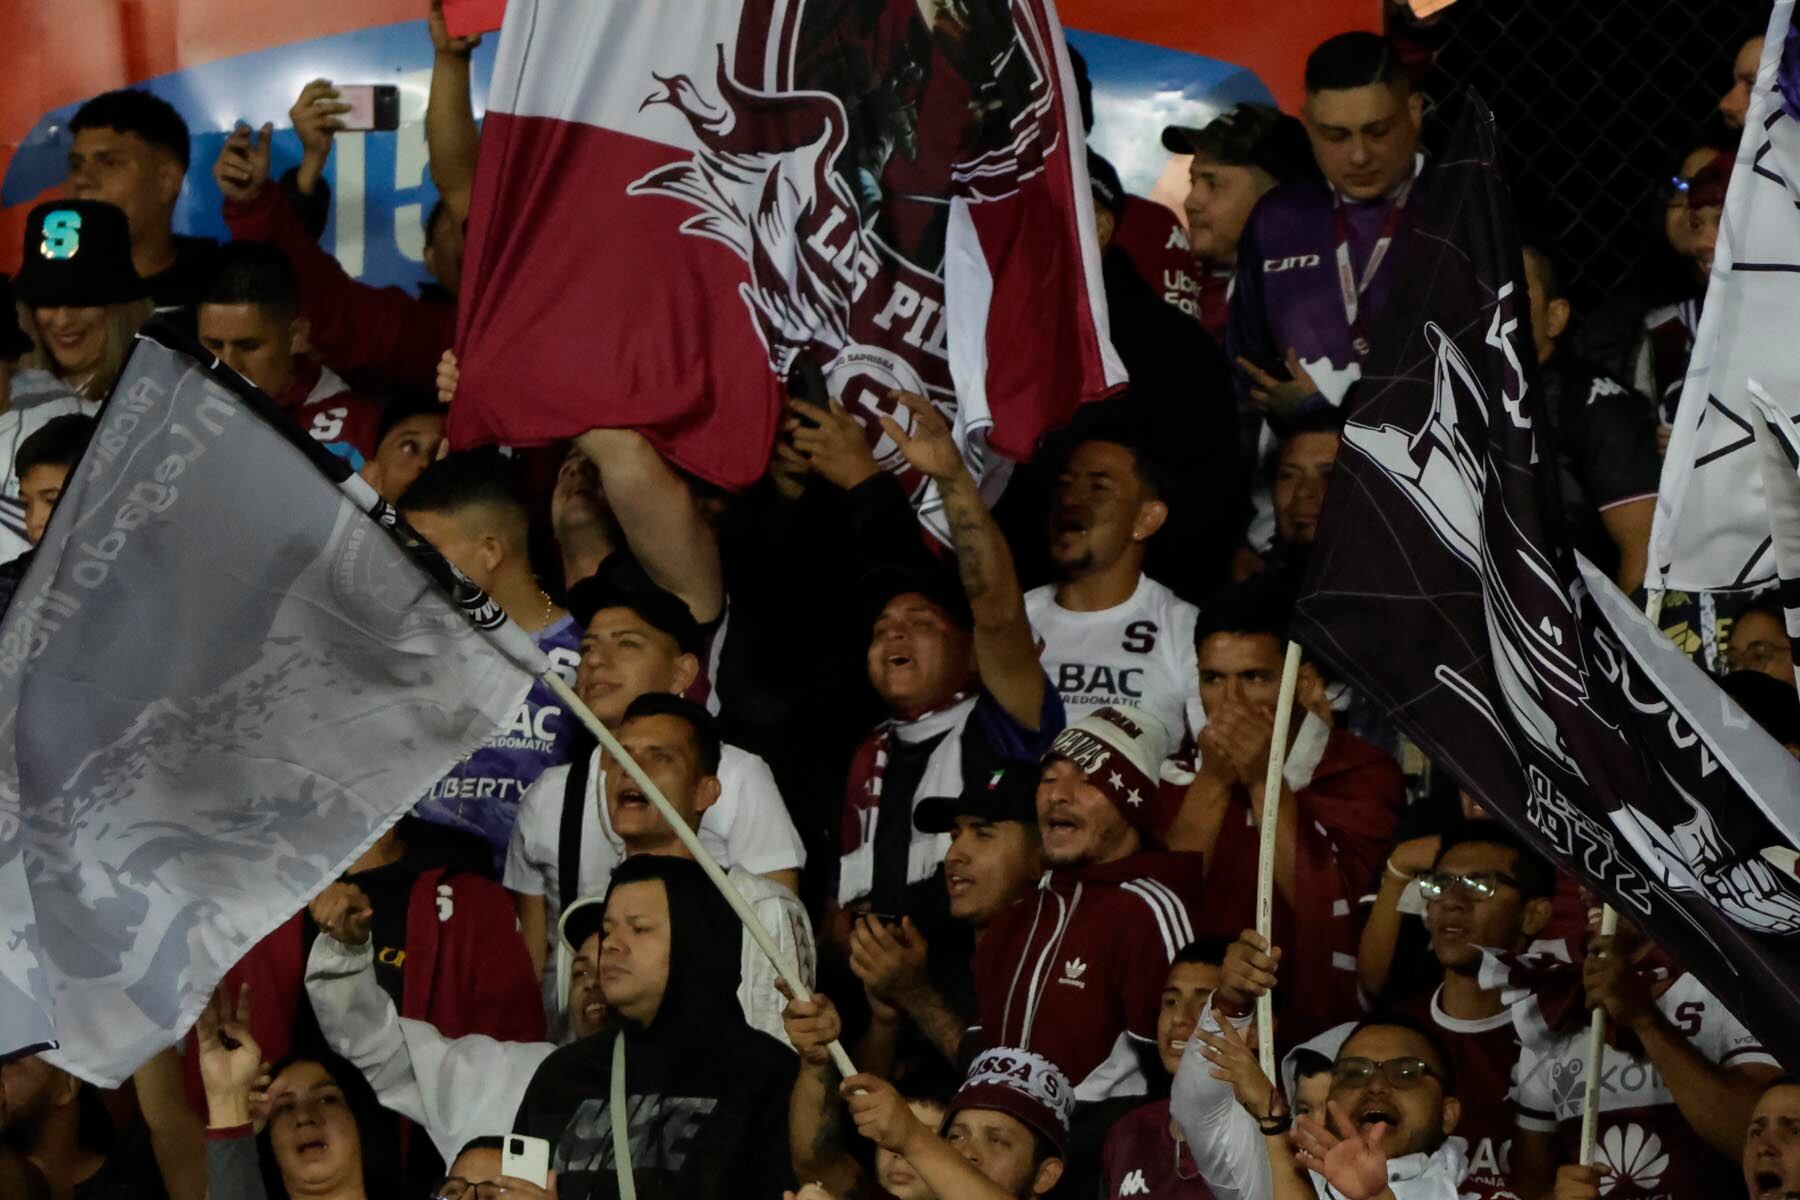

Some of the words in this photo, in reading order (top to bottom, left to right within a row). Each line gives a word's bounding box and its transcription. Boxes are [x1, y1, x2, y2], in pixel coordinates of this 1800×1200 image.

[40, 208, 82, 261] S
[308, 407, 350, 442] S
[1121, 620, 1158, 655] S
[1058, 663, 1145, 700] BAC
[1058, 694, 1142, 710] REDOMATIC
[1675, 1001, 1705, 1038] S
